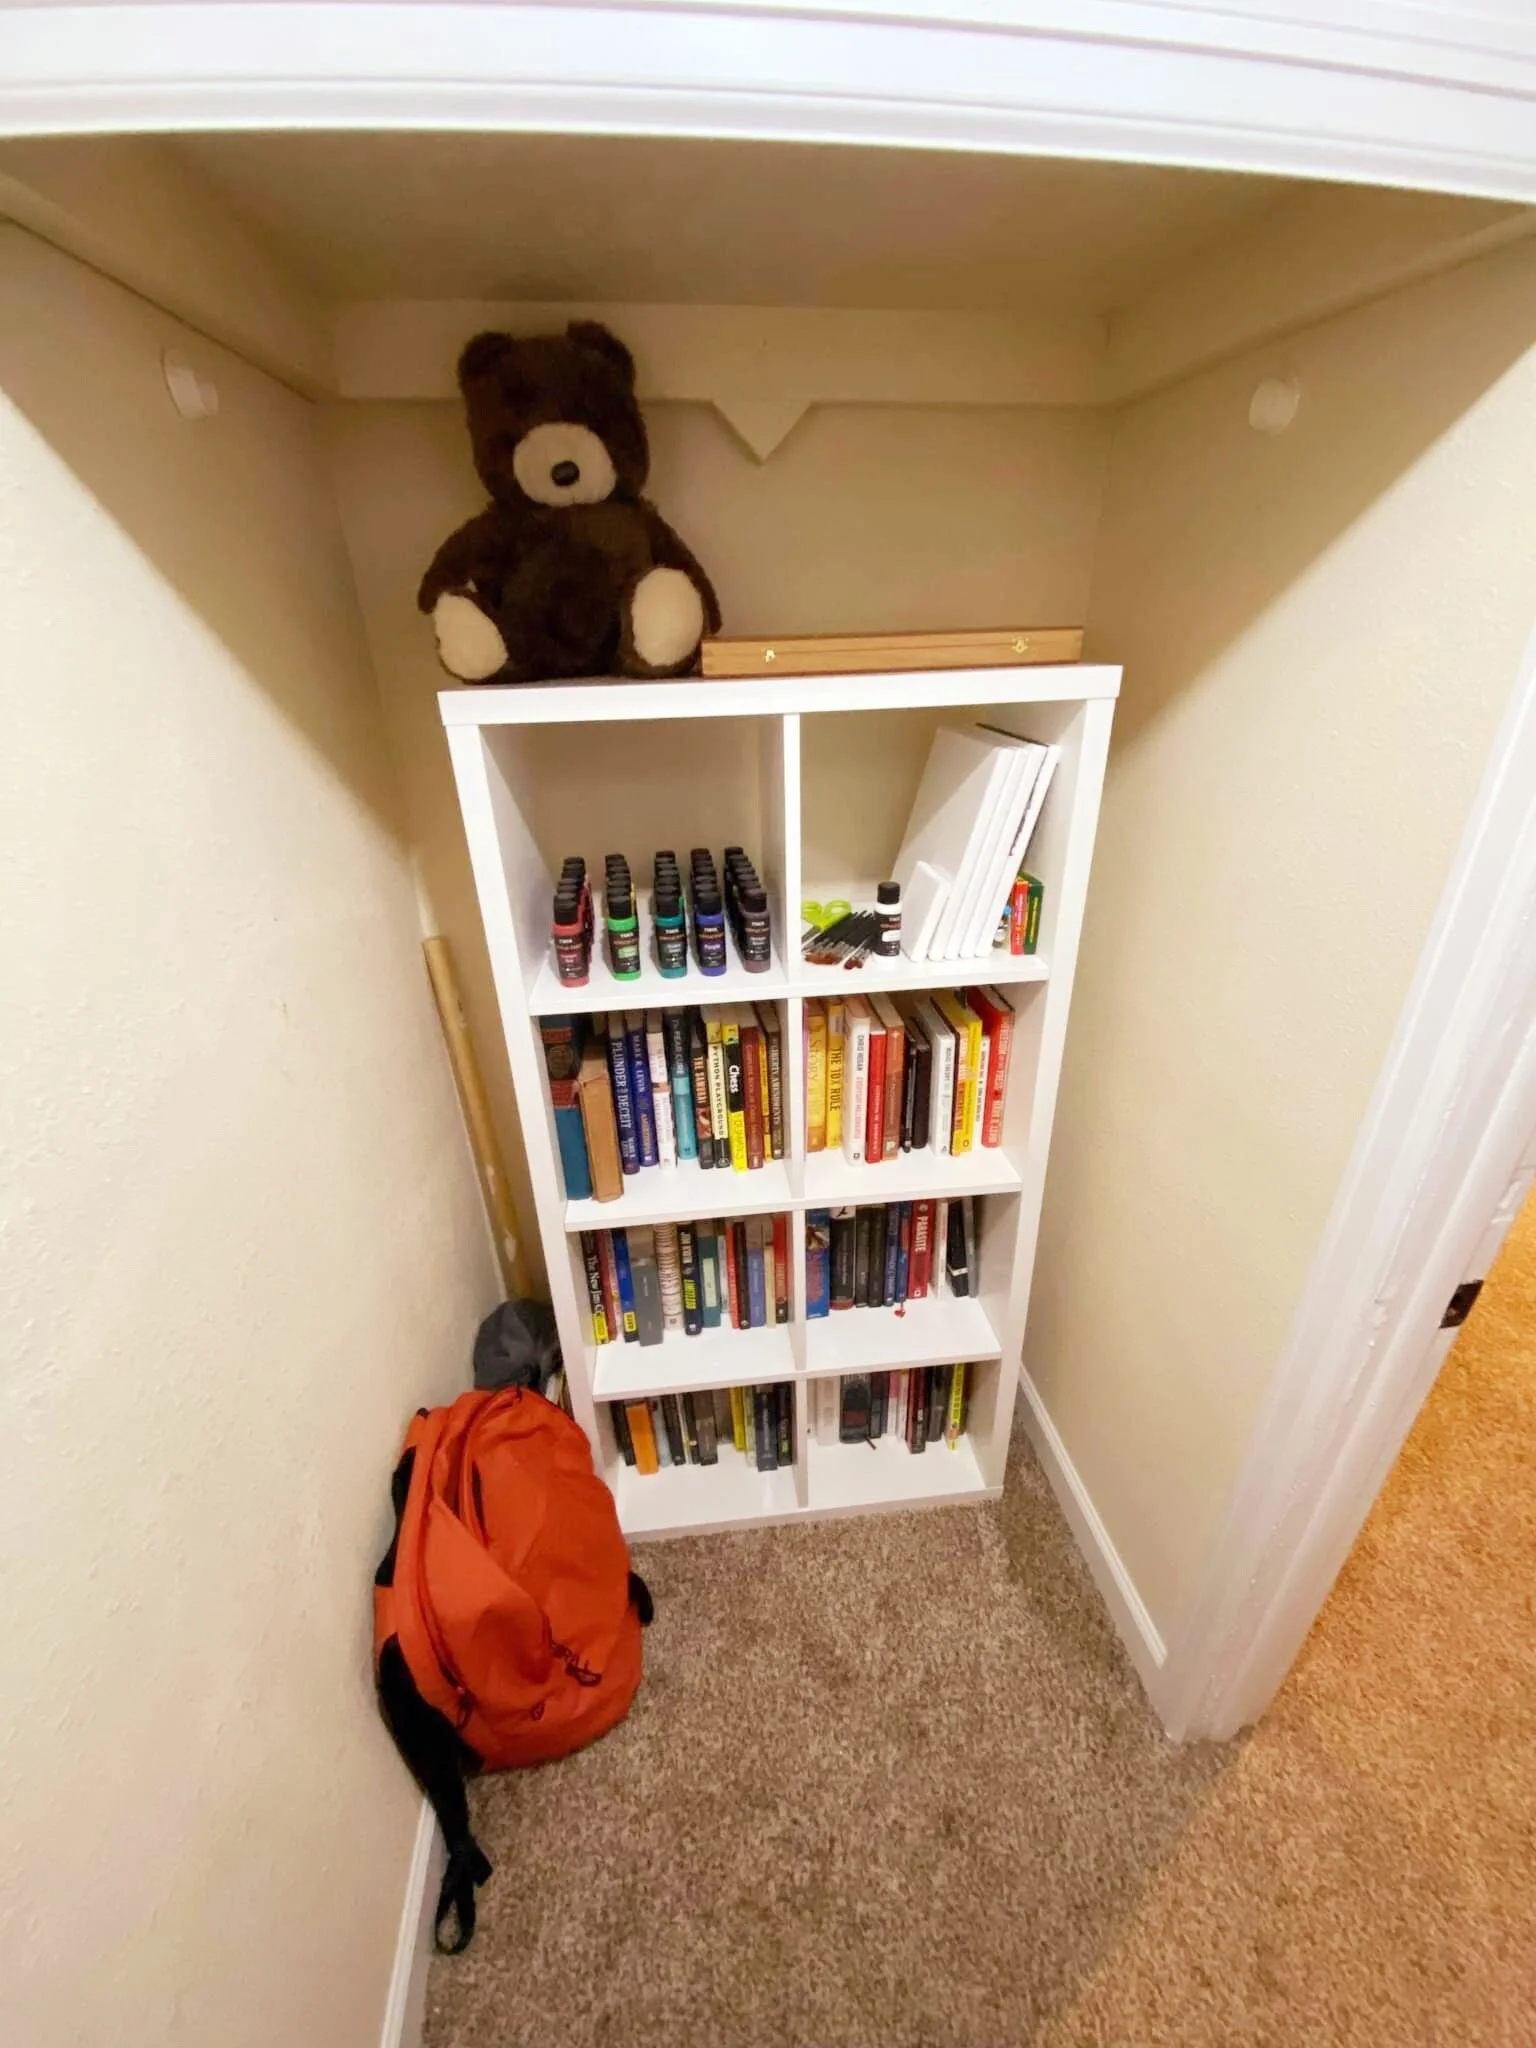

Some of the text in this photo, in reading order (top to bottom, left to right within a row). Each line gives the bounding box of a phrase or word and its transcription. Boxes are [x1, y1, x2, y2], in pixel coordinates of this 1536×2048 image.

[631, 1035, 643, 1058] MARK
[672, 1031, 682, 1052] FEAR
[610, 1041, 628, 1087] PLUNDER
[674, 1053, 685, 1075] CURE
[694, 1056, 704, 1070] THE
[635, 1069, 646, 1092] LEVIN
[712, 1045, 724, 1136] PYTHON PLAYGROUND
[728, 1064, 741, 1094] Chess
[830, 1048, 841, 1111] THE 10X RULE
[617, 1095, 632, 1129] DECEIT
[680, 1231, 691, 1245] JIM
[915, 1216, 928, 1252] PARASITE
[588, 1256, 598, 1271] The
[589, 1272, 601, 1290] New
[592, 1290, 602, 1304] Jim
